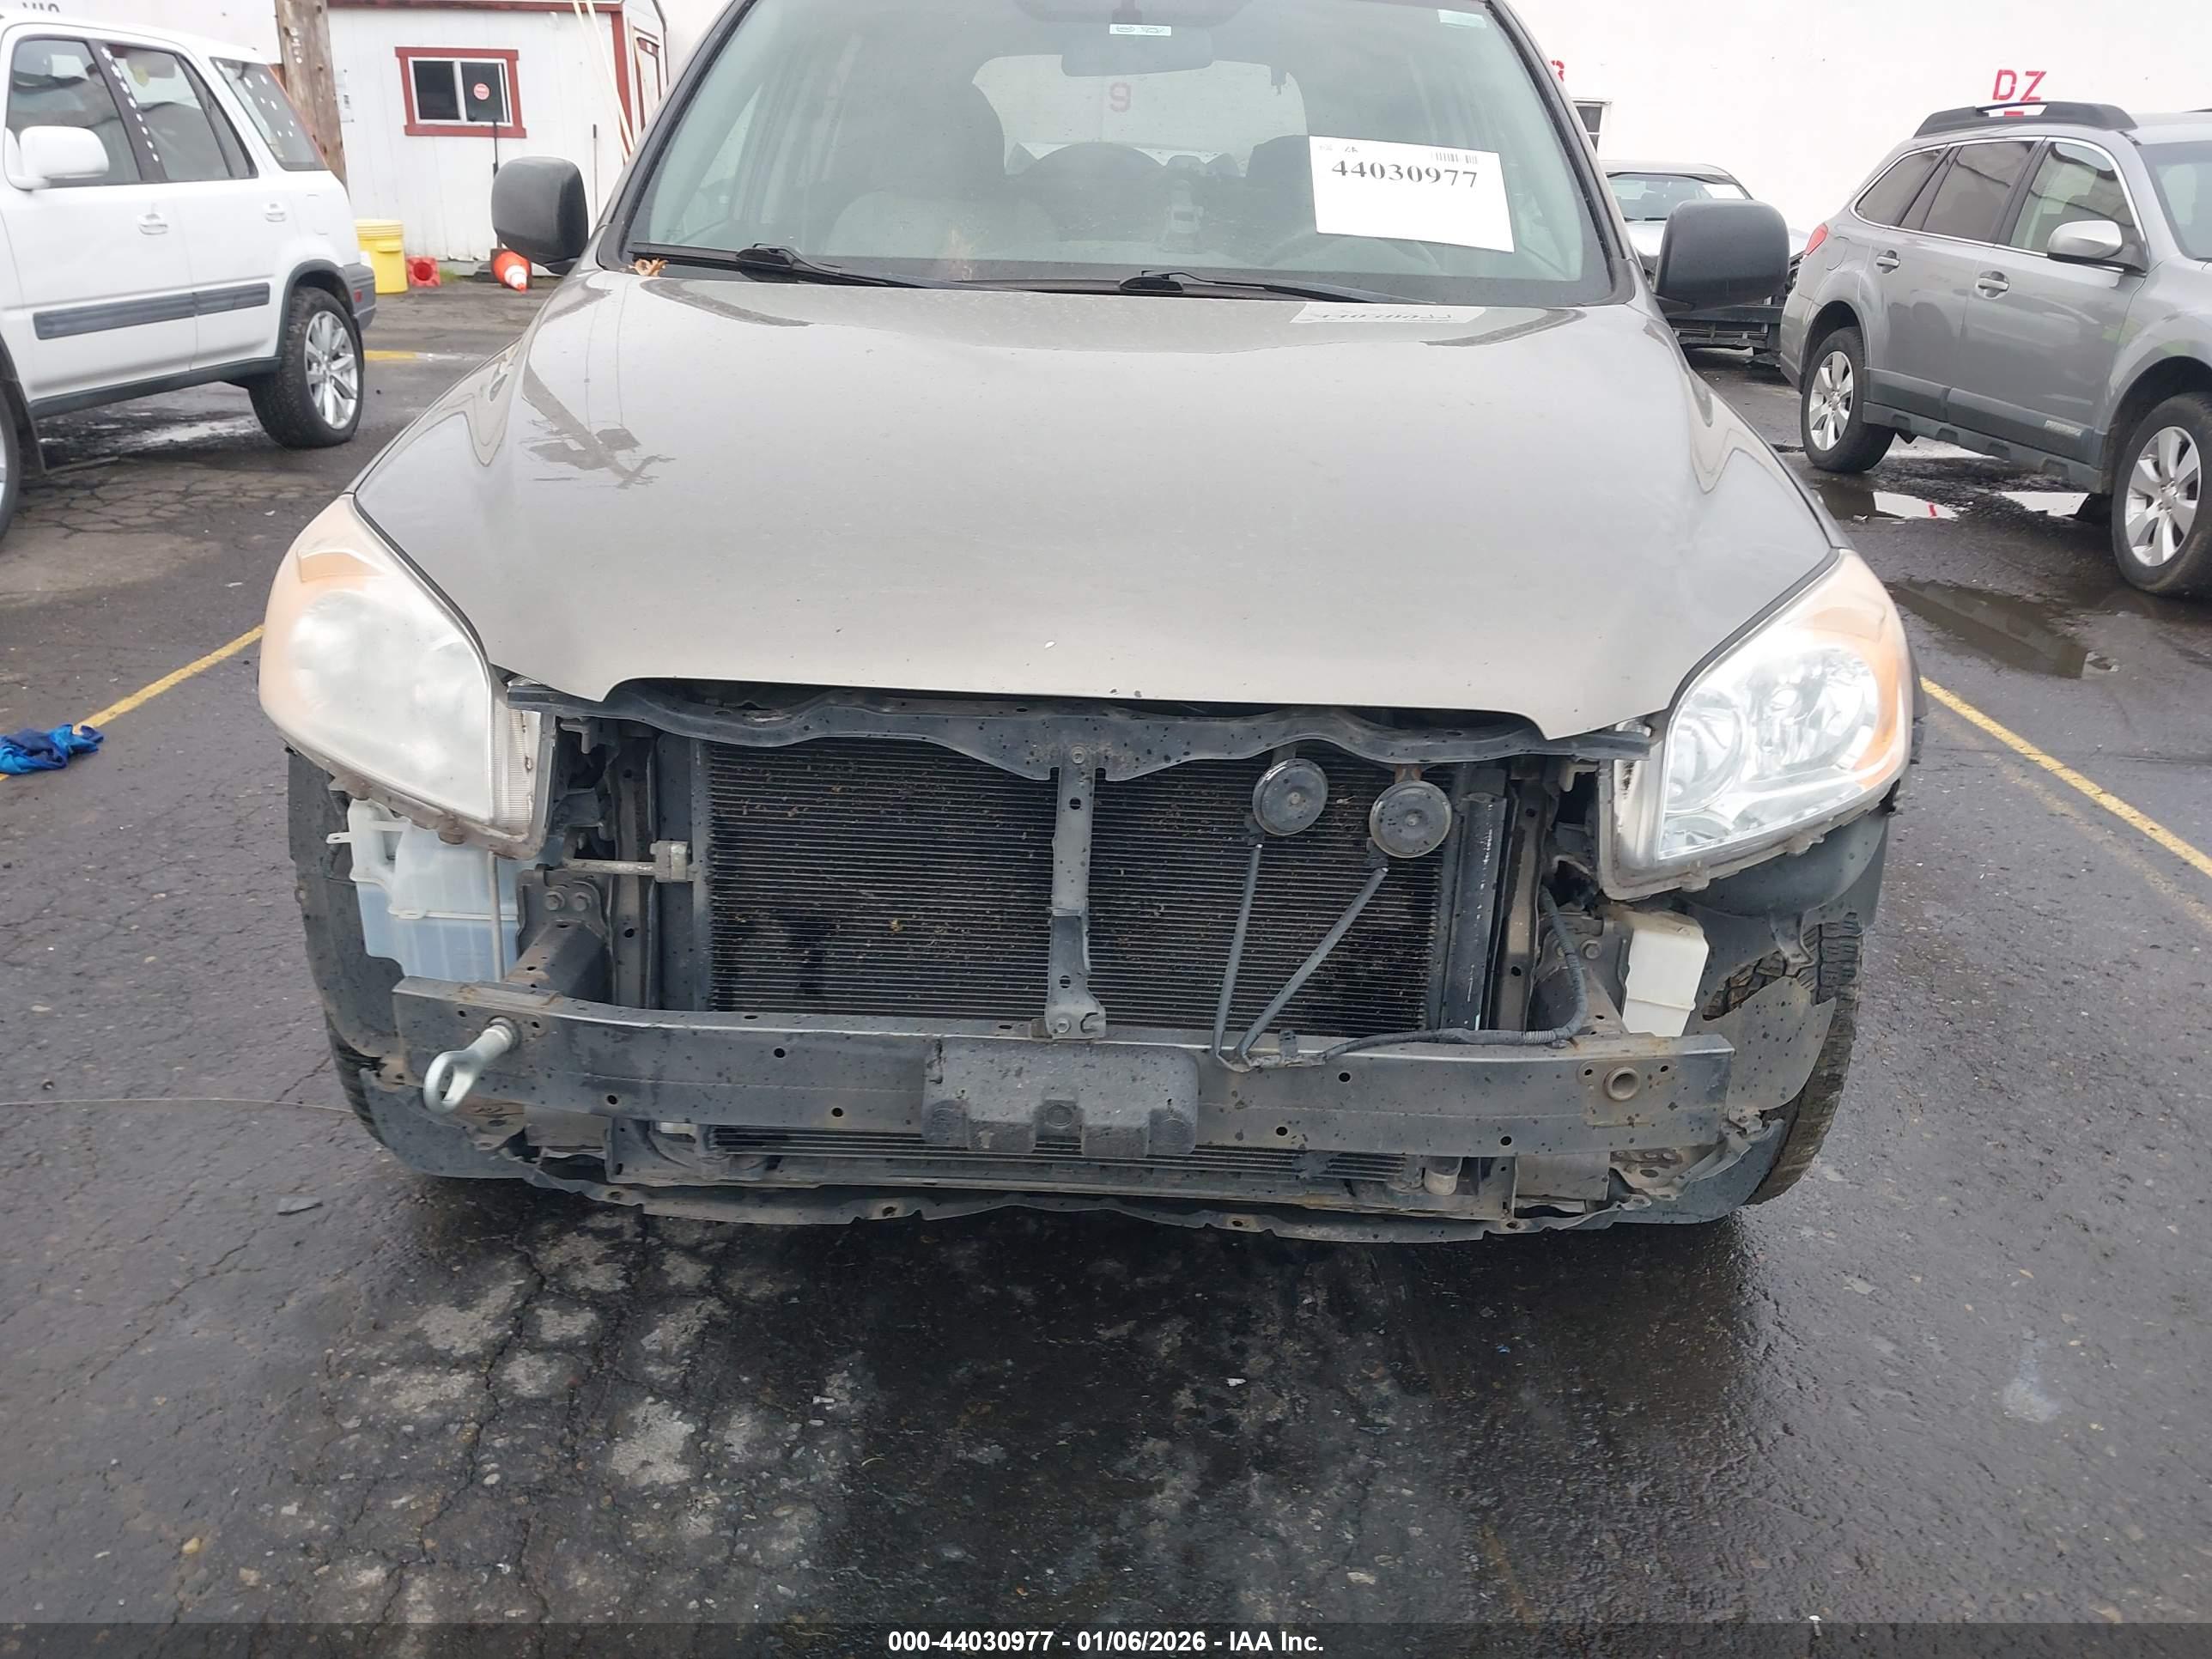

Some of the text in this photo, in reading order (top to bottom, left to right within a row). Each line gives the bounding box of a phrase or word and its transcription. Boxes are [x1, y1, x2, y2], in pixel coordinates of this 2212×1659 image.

[1109, 82, 1131, 112] 9
[1992, 69, 2047, 101] DZ
[1331, 160, 1478, 188] 44030977
